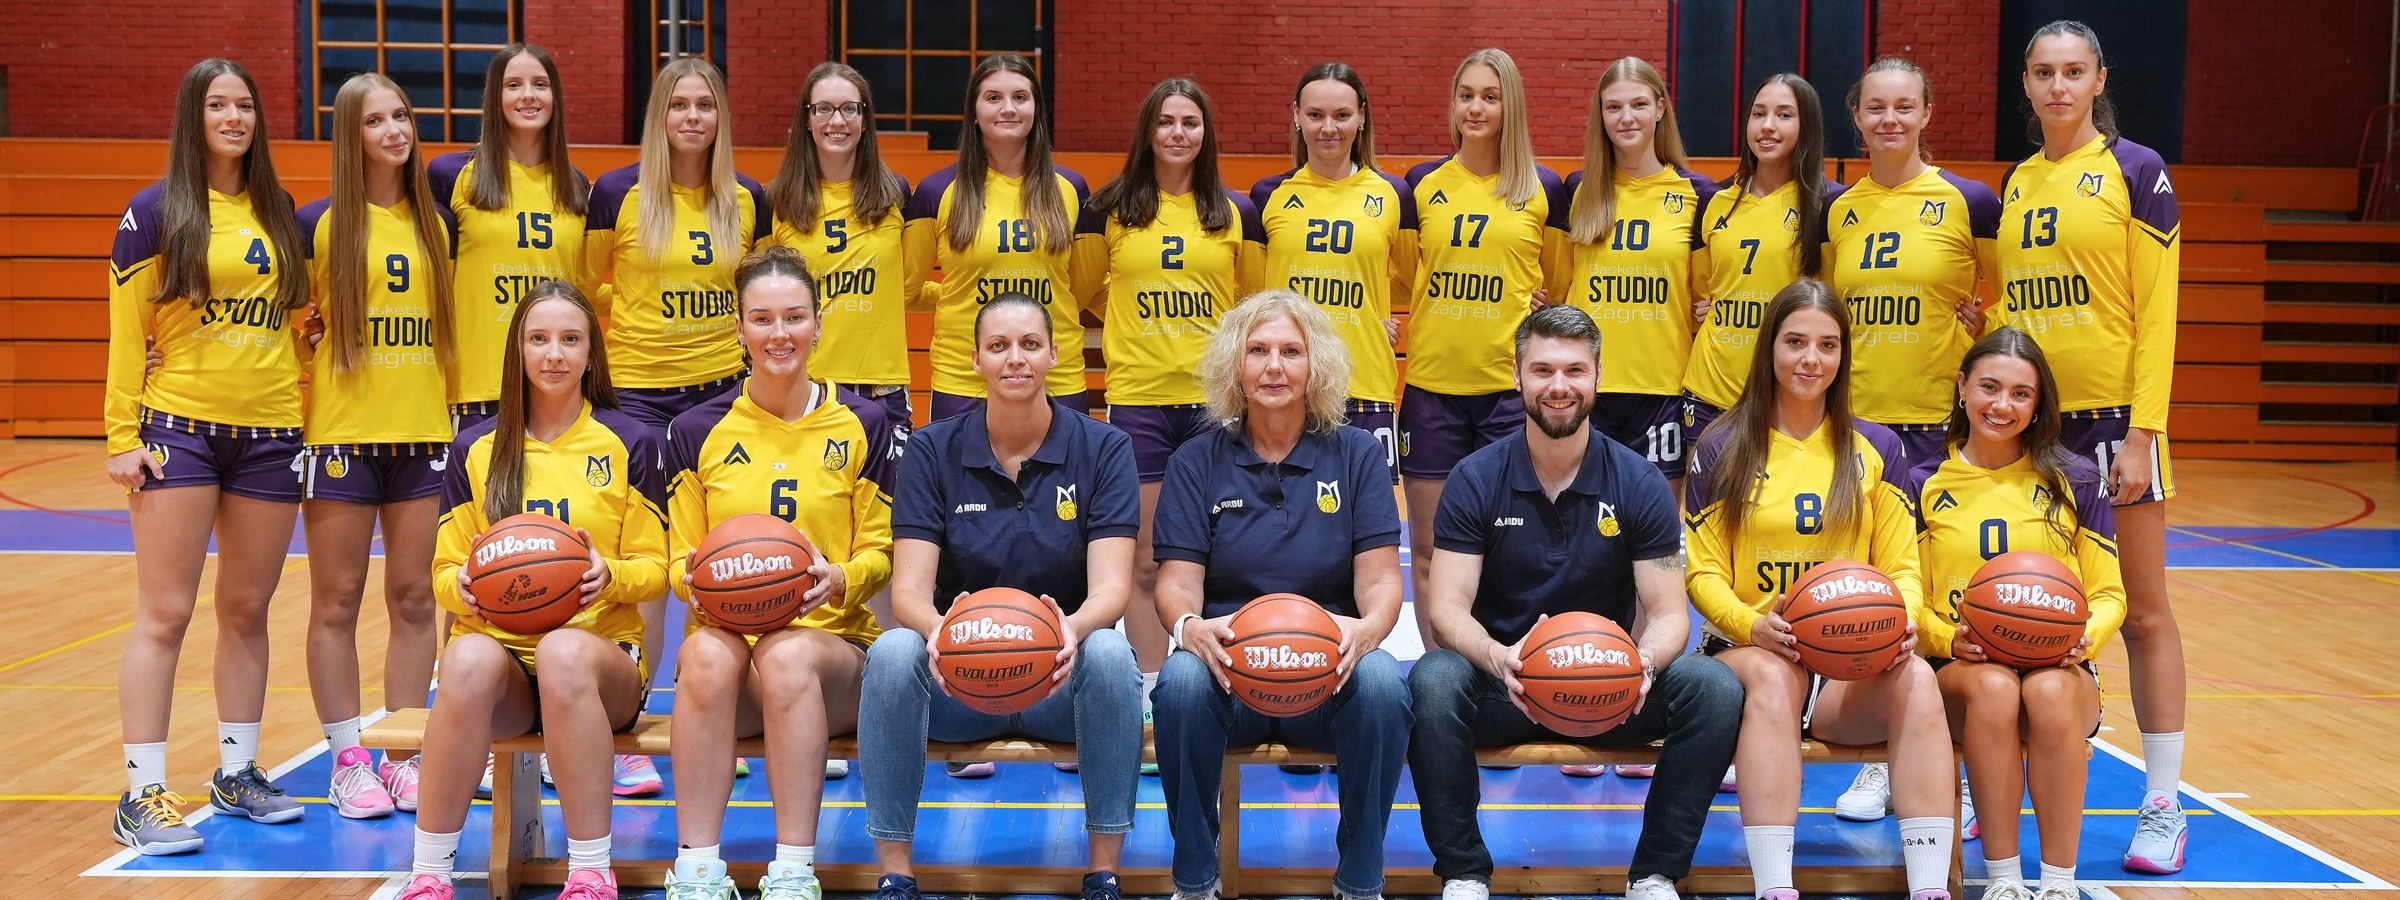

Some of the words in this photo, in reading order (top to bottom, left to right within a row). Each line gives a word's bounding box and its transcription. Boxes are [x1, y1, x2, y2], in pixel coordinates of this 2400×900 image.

[516, 211, 553, 249] 15
[824, 218, 848, 254] 5
[997, 219, 1035, 253] 18
[1306, 218, 1355, 254] 20
[1450, 213, 1490, 248] 17
[1611, 219, 1650, 251] 10
[2022, 206, 2059, 249] 13
[243, 238, 271, 275] 4
[688, 230, 714, 266] 3
[1161, 235, 1184, 270] 2
[1739, 238, 1760, 275] 7
[1859, 231, 1901, 270] 12
[385, 253, 410, 293] 9
[1288, 264, 1364, 280] Basketball
[1589, 263, 1671, 277] Basketball
[1288, 276, 1364, 310] STUDIO
[1427, 271, 1504, 303] STUDIO
[1588, 275, 1669, 305] STUDIO
[2006, 274, 2090, 313] STUDIO
[200, 296, 284, 332] STUDIO
[662, 290, 735, 318] STUDIO
[1136, 290, 1214, 319] STUDIO
[1427, 299, 1501, 320] Zagreb
[1588, 304, 1668, 324] Zagreb
[368, 316, 434, 347] TUDIO
[1140, 319, 1216, 338] Zagreb
[2007, 307, 2094, 334] Zagreb
[191, 327, 278, 350] Zagreb
[371, 347, 437, 369] agreb
[1645, 421, 1682, 463] 10
[770, 478, 798, 524] 6
[963, 503, 987, 512] ARDU
[1221, 498, 1244, 509] ARDU
[1794, 492, 1824, 536] 8
[475, 535, 558, 568] Wilson
[709, 552, 794, 582] Wilson
[720, 588, 796, 613] EVOLUTION
[1808, 575, 1894, 605] Wilson
[1995, 583, 2076, 615] Wilson
[949, 616, 1034, 645] Wilson
[1821, 616, 1896, 637] EVOLUTION
[1991, 624, 2071, 647] EVOLUTION
[954, 661, 1034, 680] EVOLUTION
[1243, 644, 1328, 669] Wilson
[1545, 642, 1631, 669] Wilson
[1248, 684, 1327, 704] EVOLUTION
[1551, 687, 1630, 706] EVOLUTION
